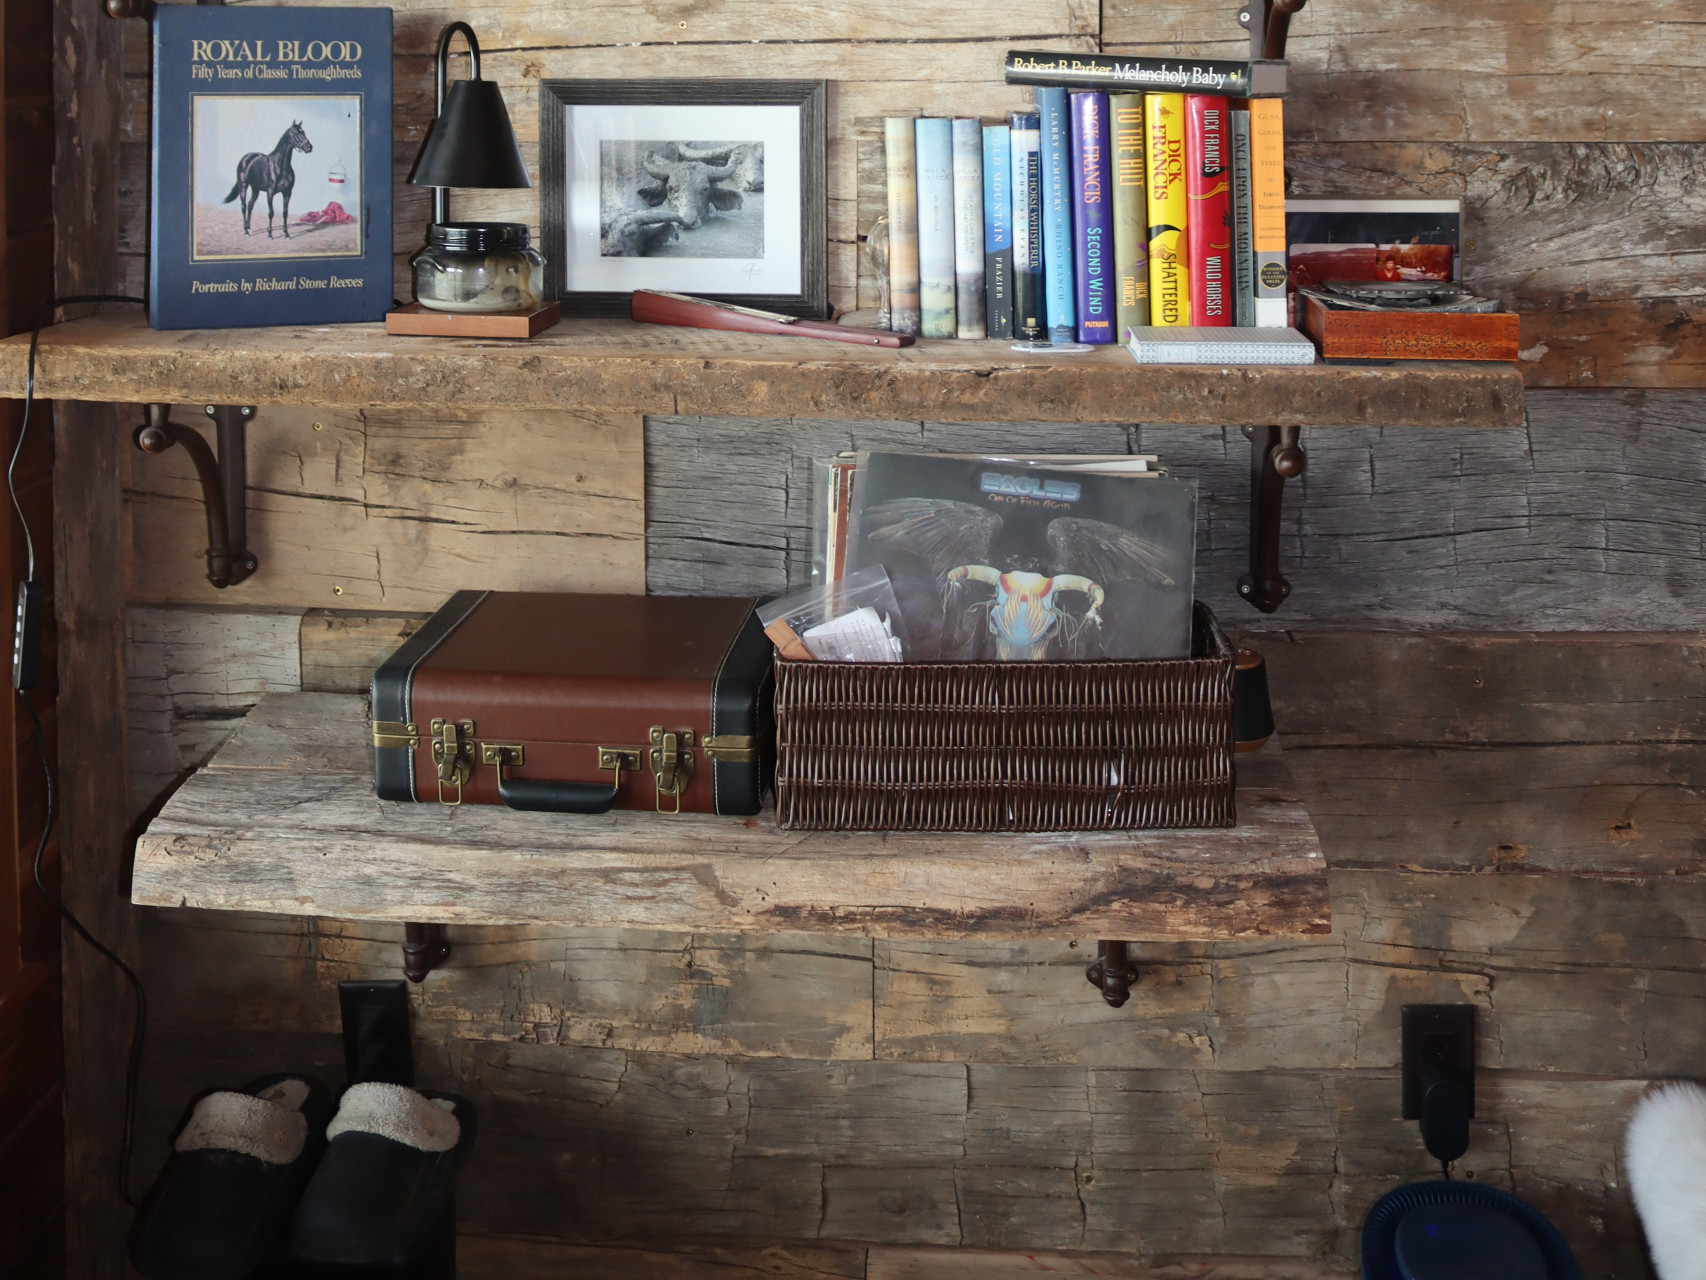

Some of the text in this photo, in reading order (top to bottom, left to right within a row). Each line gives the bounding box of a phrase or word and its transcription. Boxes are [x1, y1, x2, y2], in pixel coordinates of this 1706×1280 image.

[191, 39, 362, 62] ROYAL BLOOD
[192, 64, 362, 82] Fifty Years of Classic Thoroughbreds
[1013, 57, 1056, 72] Robert
[1058, 60, 1070, 74] B.
[1071, 60, 1113, 76] Parker
[1113, 62, 1191, 87] Melancholy
[1192, 66, 1226, 90] Baby
[1258, 113, 1281, 121] GUNS,
[1051, 112, 1062, 212] LARRY McMURTRY
[1082, 105, 1102, 205] DICK FRANCIS
[1117, 106, 1144, 187] TO THE HILT
[1152, 124, 1169, 201] FRANCIS
[1167, 139, 1182, 185] DICK
[1203, 109, 1220, 173] DICK FRANCIS
[1235, 133, 1247, 163] ONCE
[1236, 168, 1248, 199] UPON
[1260, 159, 1281, 167] STEEL
[992, 171, 1003, 243] MOUNTAIN
[1029, 155, 1040, 269] THE HORSE WHISPERER
[1237, 203, 1249, 228] THE
[995, 257, 1004, 300] FRAZIER
[1054, 224, 1065, 301] RHINO RANCH
[1086, 227, 1103, 315] SECOND WIND
[1237, 236, 1249, 291] MOUNTAIN
[191, 275, 363, 294] Portraits by Richard Stone Reeves
[1122, 276, 1135, 307] FRANCIS
[1135, 281, 1146, 299] DICK
[1161, 253, 1178, 324] SHATTERED
[1206, 255, 1222, 317] WILD HORSES
[981, 472, 1081, 501] EAGLES
[1006, 496, 1018, 504] OF
